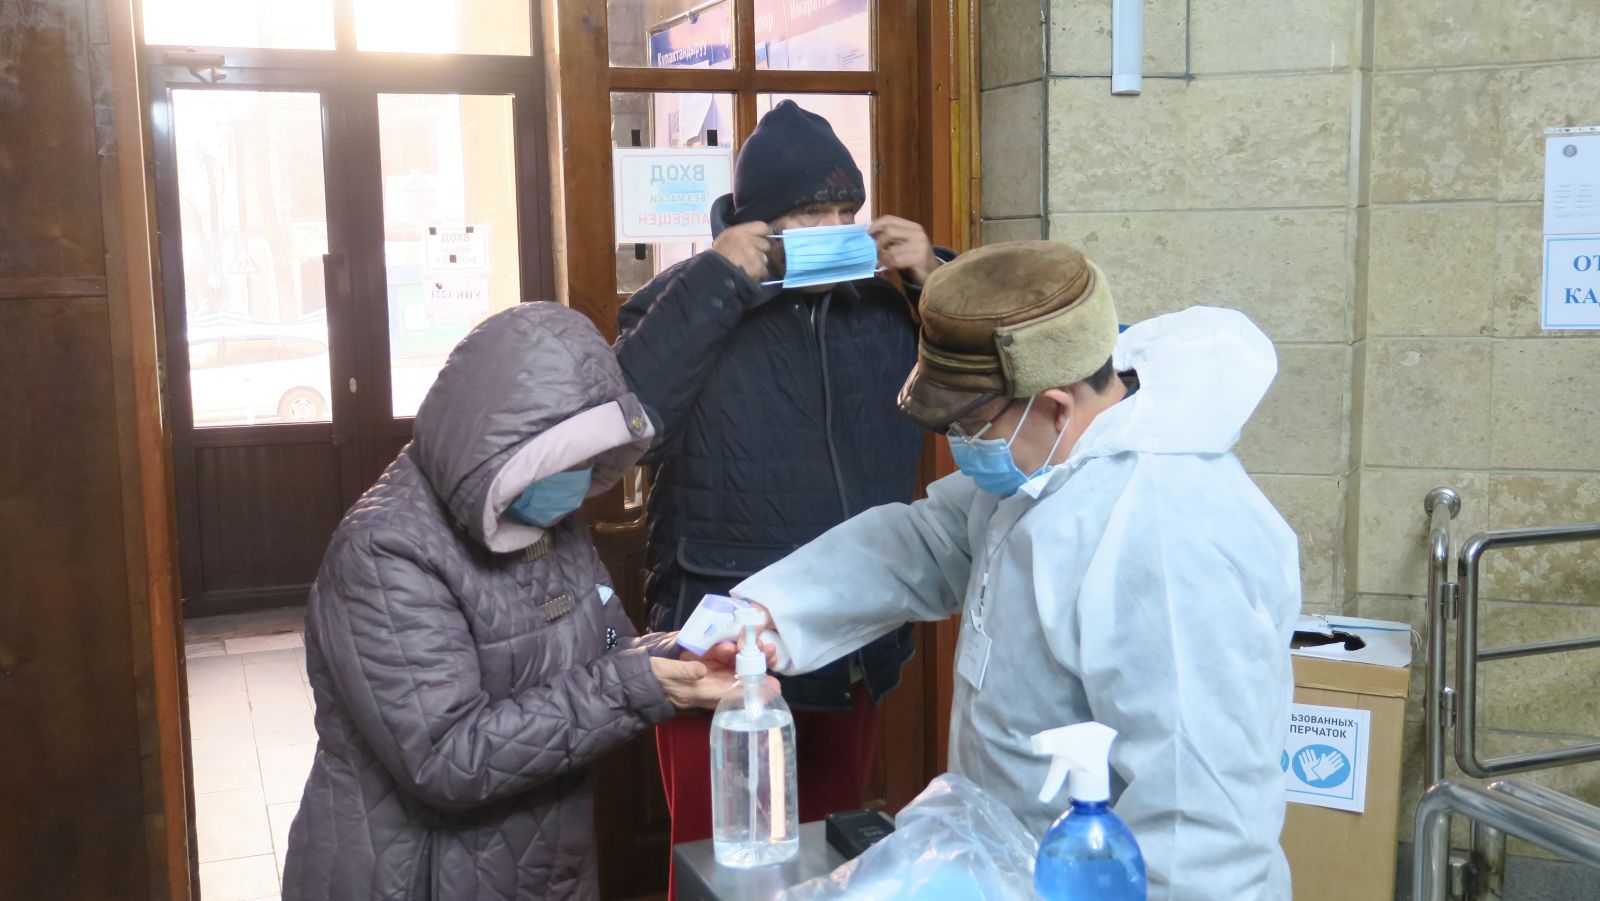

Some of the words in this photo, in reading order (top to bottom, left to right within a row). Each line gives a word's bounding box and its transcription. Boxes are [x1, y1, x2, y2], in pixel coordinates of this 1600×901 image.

[1564, 287, 1600, 306] КА
[1291, 714, 1354, 727] ЬЗОВАННЫХ
[1290, 724, 1347, 739] ПЕРЧАТОК
